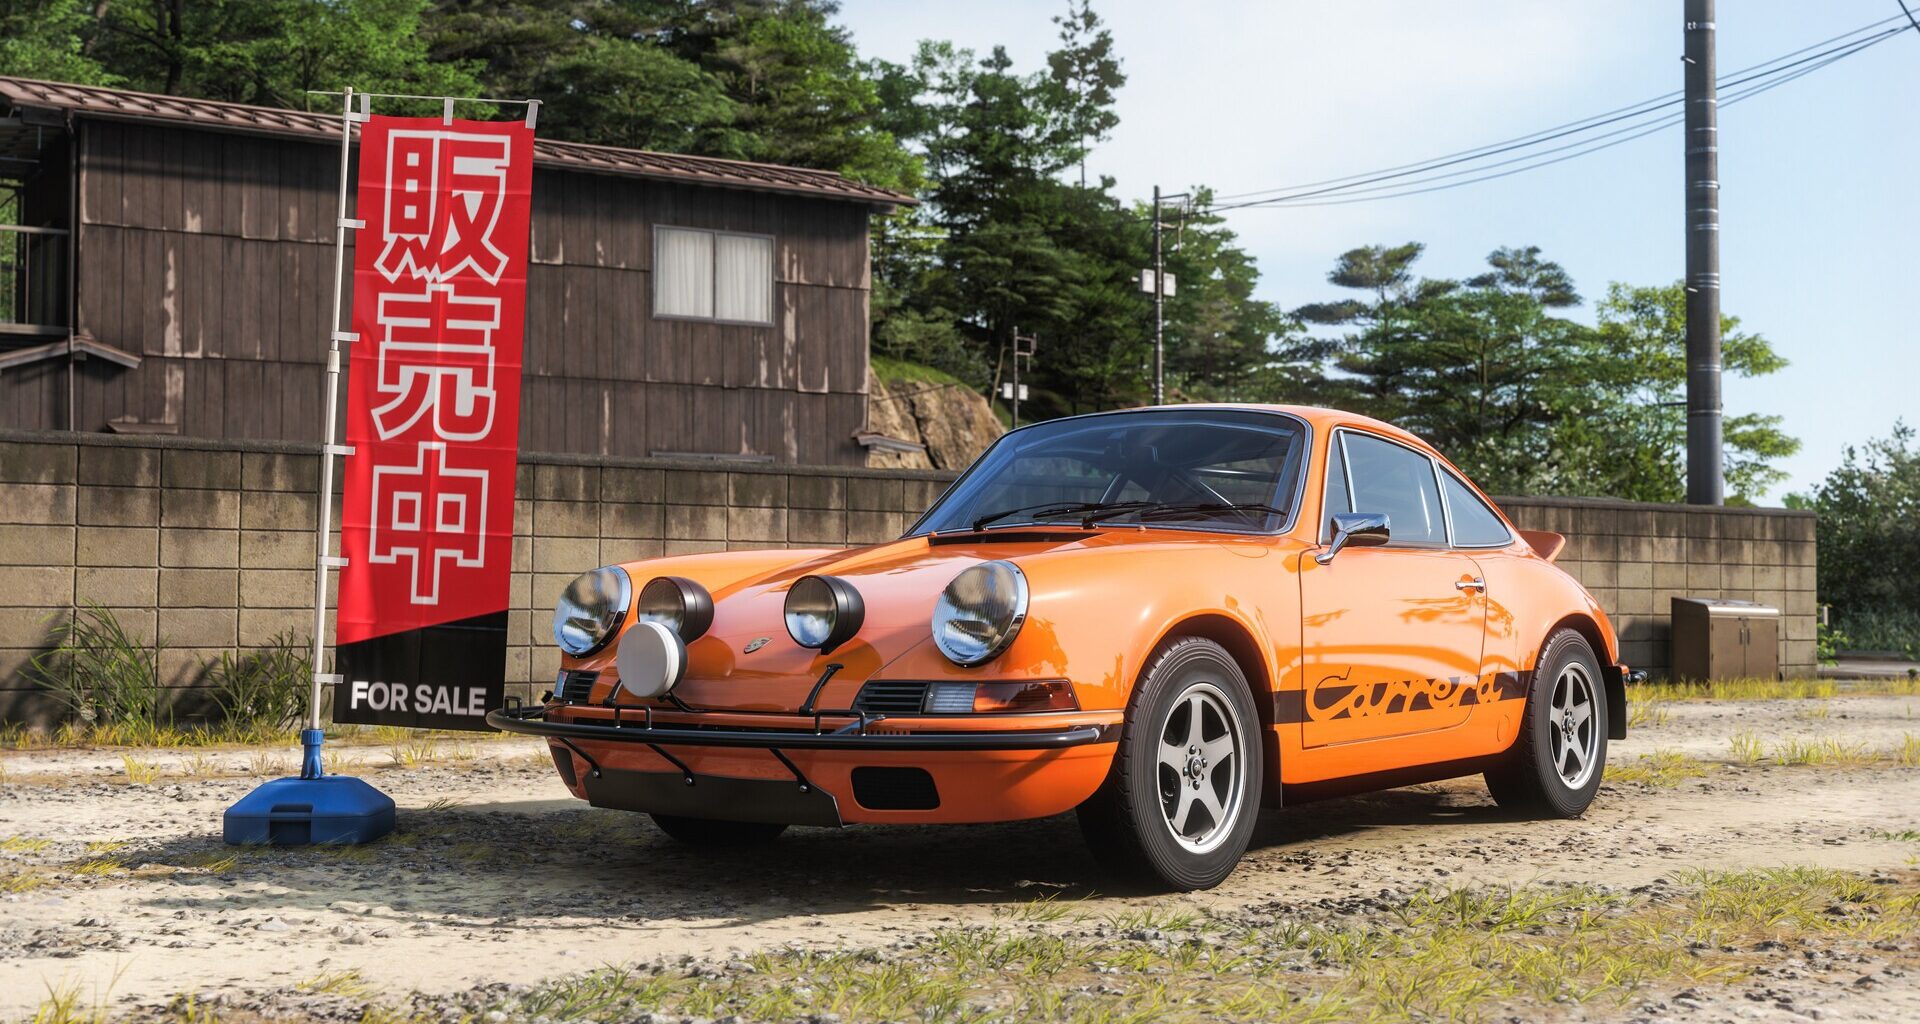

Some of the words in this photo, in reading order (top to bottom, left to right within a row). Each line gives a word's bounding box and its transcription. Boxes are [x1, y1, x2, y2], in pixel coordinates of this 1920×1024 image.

[368, 128, 511, 606] 販売中
[350, 680, 409, 713] FOR
[414, 683, 487, 717] SALE
[1305, 666, 1504, 722] Carrera
